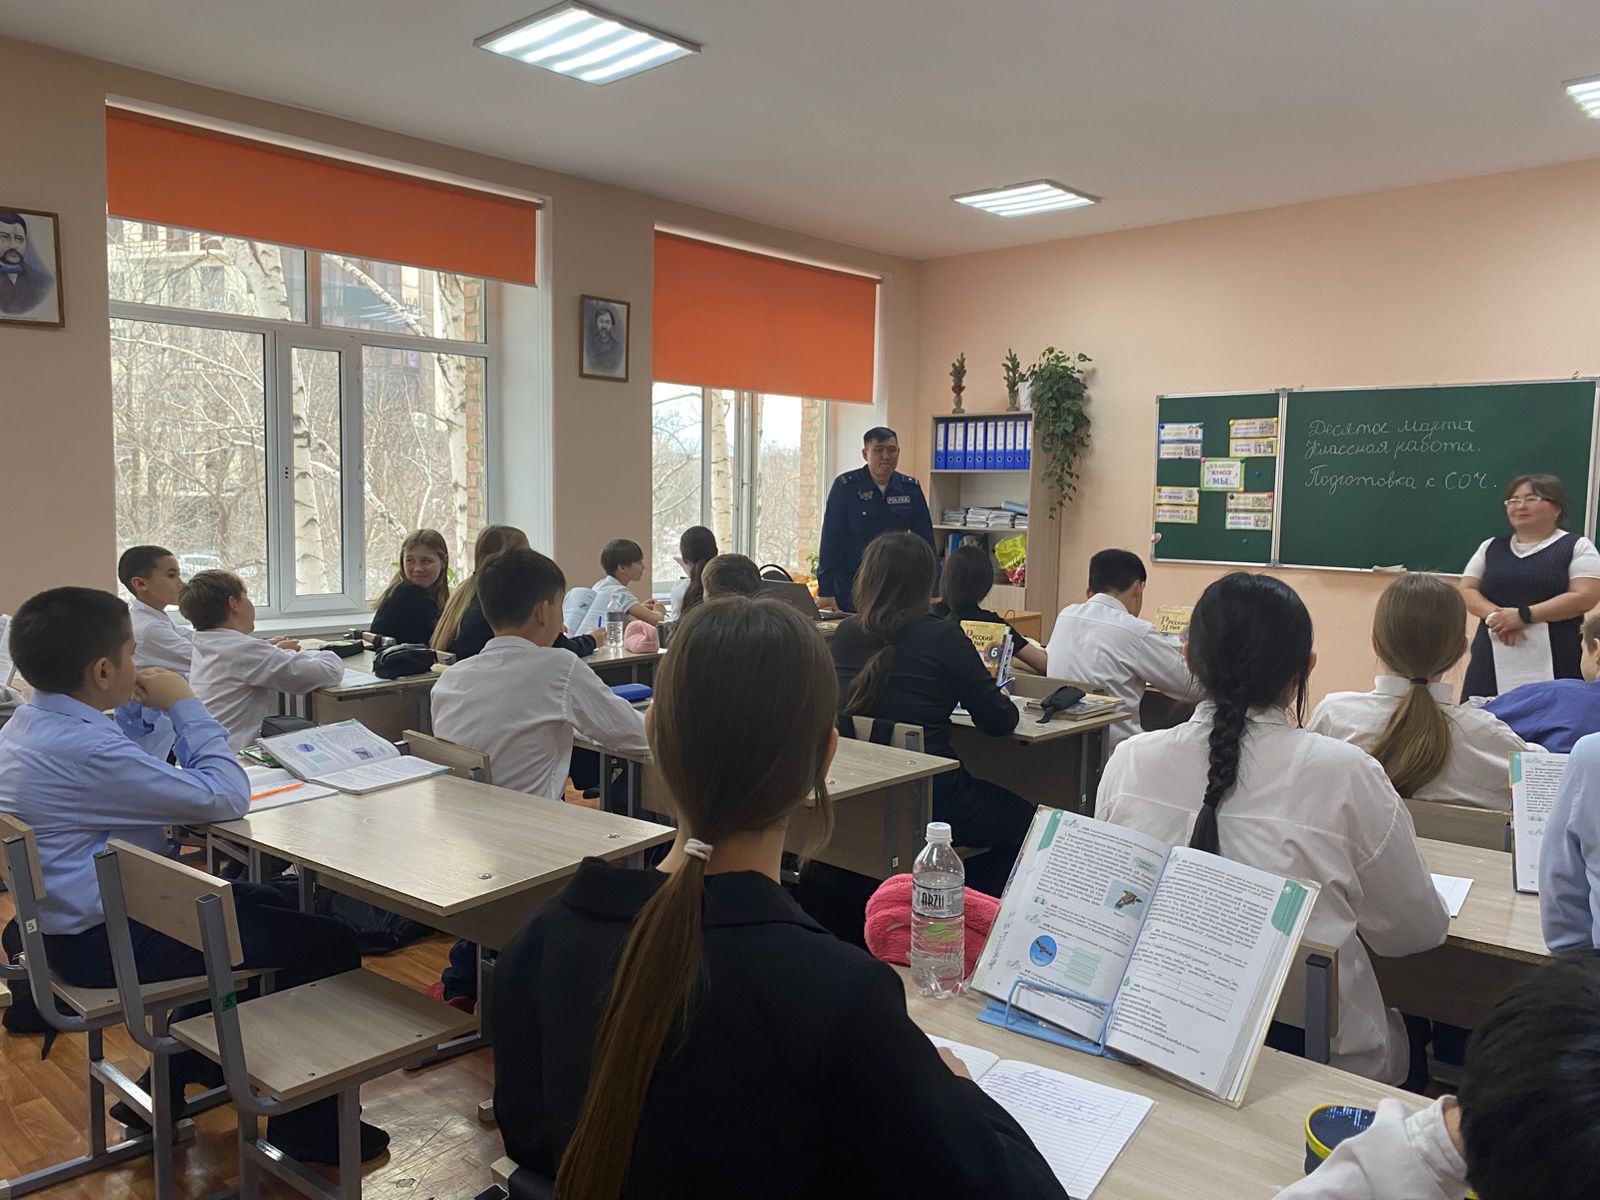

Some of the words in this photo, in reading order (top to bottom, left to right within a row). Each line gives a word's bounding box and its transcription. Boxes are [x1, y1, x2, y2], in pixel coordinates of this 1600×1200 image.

[1308, 419, 1390, 437] Десятое
[1304, 439, 1392, 459] Классная
[1394, 433, 1481, 460] работа.
[1304, 464, 1418, 496] Подготовка
[990, 647, 999, 658] 6
